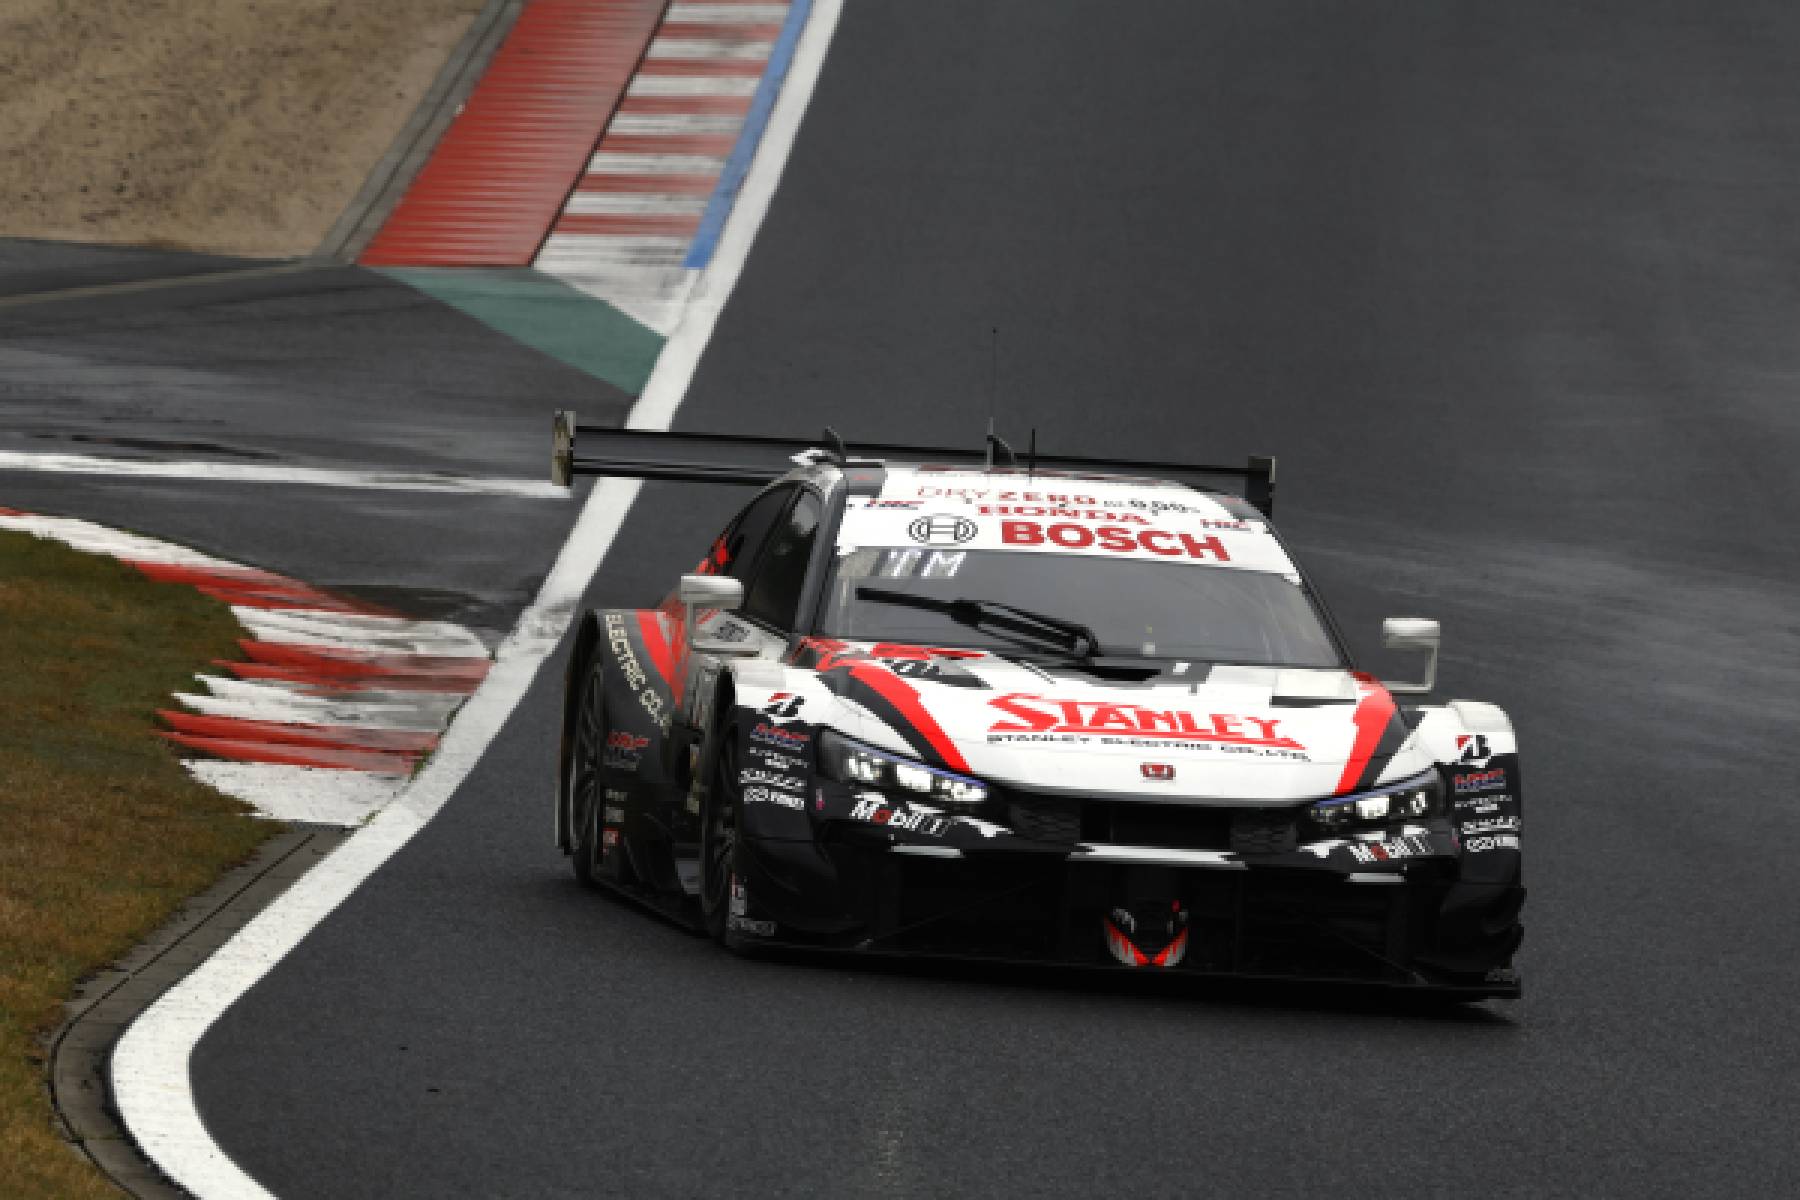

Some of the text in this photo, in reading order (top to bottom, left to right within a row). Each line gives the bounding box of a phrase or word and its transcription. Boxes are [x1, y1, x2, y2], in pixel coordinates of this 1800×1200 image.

[998, 490, 1097, 506] ZERO
[977, 504, 1152, 525] HONDA
[1001, 519, 1231, 562] BOSCH
[605, 614, 648, 691] ELECTRIC
[986, 692, 1283, 743] STANLEY
[986, 733, 1091, 744] STANLEY
[1100, 737, 1213, 752] ELECTRIC
